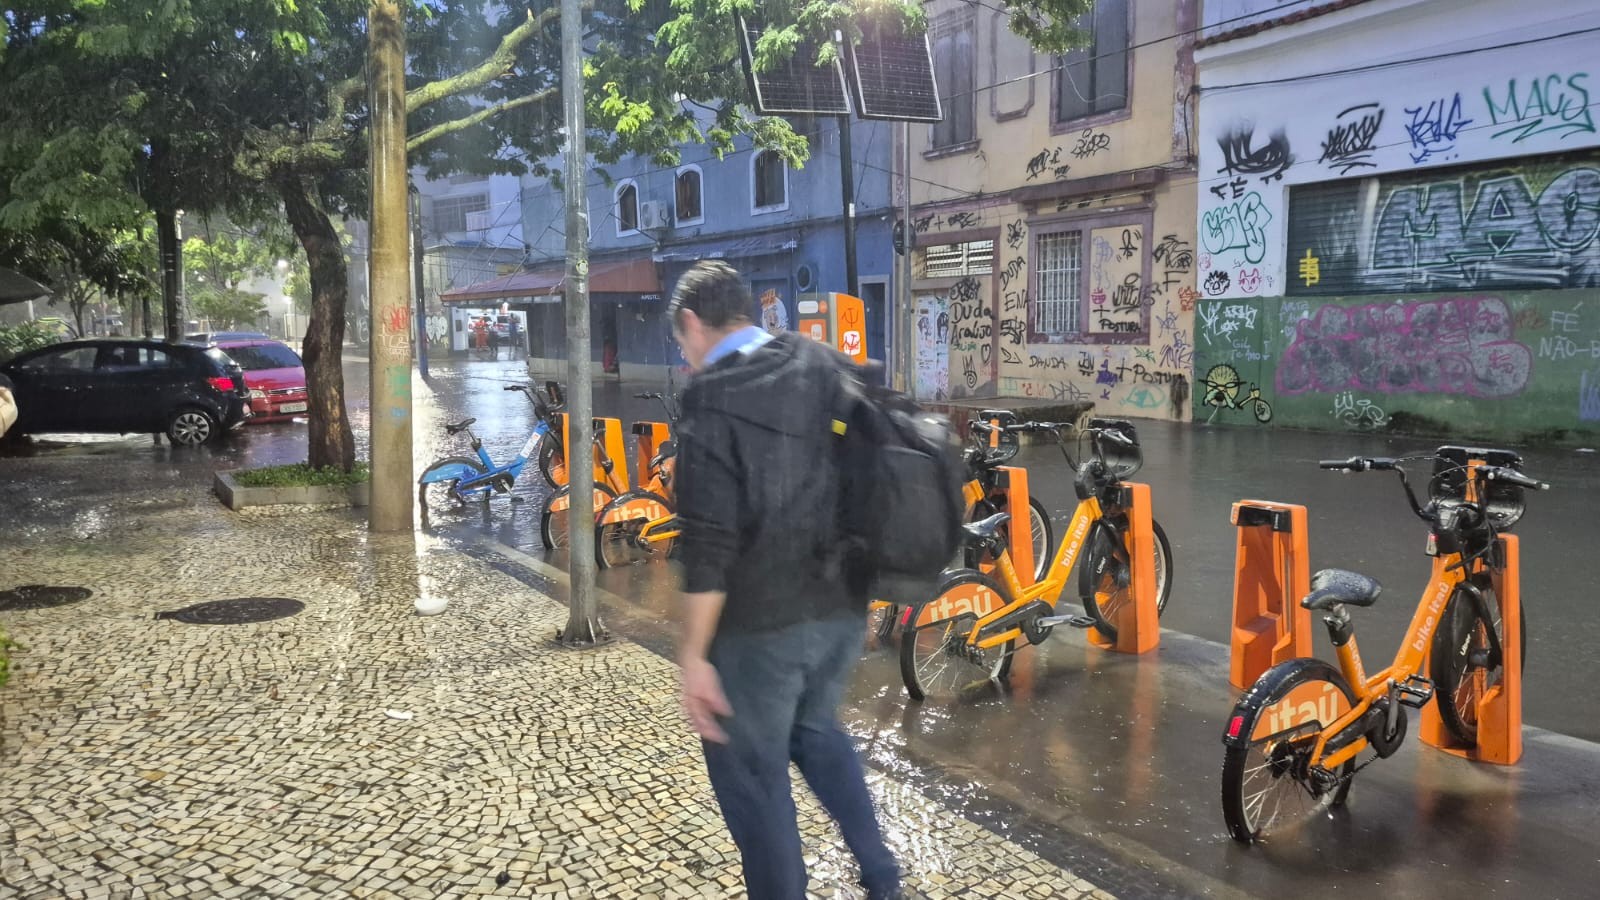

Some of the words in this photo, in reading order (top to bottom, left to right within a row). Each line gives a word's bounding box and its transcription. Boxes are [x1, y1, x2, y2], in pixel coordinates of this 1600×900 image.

[1550, 301, 1584, 332] FÉ
[613, 500, 660, 522] itaú
[1061, 541, 1078, 567] bike
[929, 584, 993, 623] itaú
[1412, 615, 1435, 652] bike
[1270, 682, 1338, 736] itaú
